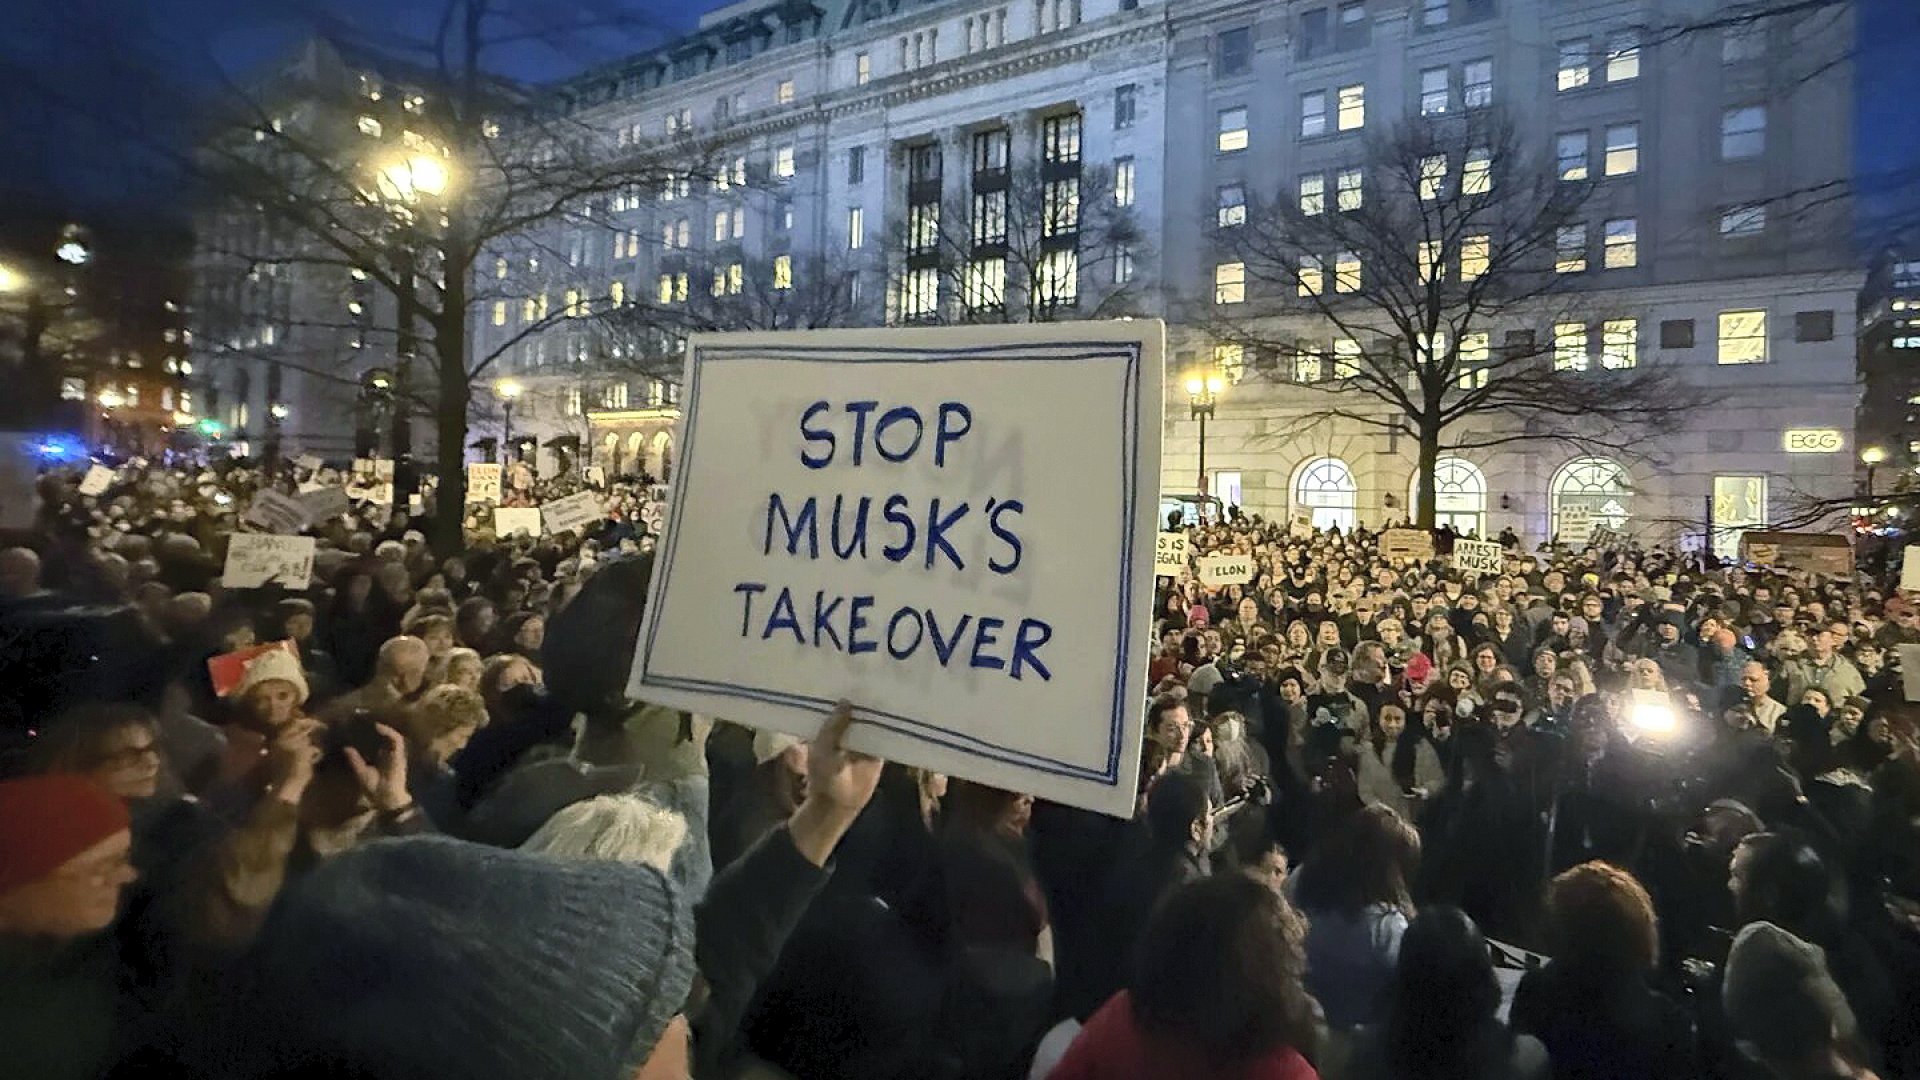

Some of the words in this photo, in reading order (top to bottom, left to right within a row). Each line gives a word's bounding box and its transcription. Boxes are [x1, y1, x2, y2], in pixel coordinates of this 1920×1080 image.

[800, 400, 972, 470] STOP
[763, 493, 1024, 575] MUSK'S
[1456, 542, 1501, 557] ARREST
[1215, 564, 1246, 577] ELON
[1459, 555, 1500, 571] MUSK
[733, 583, 1053, 682] TAKEOVER
